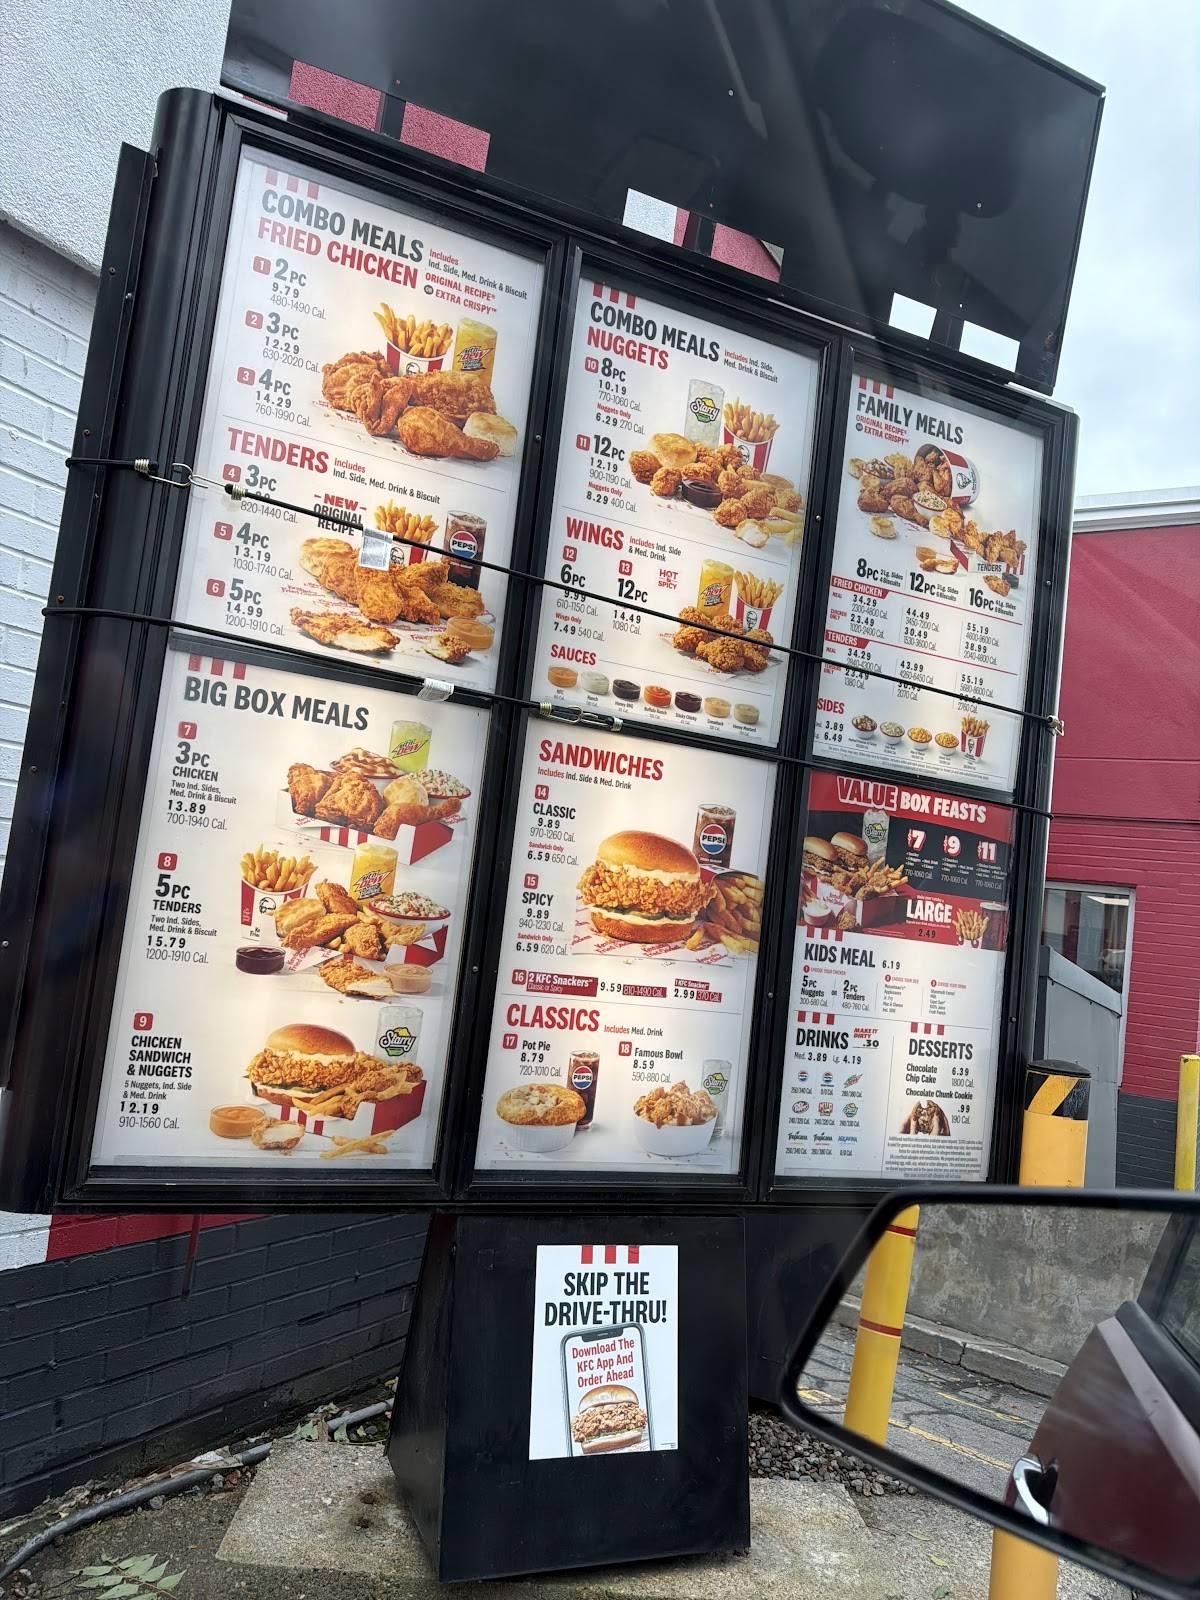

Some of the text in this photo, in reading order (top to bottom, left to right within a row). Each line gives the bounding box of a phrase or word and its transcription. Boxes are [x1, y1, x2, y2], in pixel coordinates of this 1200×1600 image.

[262, 189, 423, 262] COMBO MEALS
[258, 217, 418, 288] FRIED CHICKEN
[430, 249, 458, 265] Includes
[425, 273, 462, 292] ORIGINAL
[429, 260, 527, 299] Ind. Side, Med. Drink & Biscuit
[272, 283, 300, 299] 9.79
[270, 295, 327, 319] 480-1490 Cal.
[591, 302, 720, 361] COMBO MEALS
[265, 336, 300, 355] 12.29
[587, 326, 669, 369] NUGGETS
[599, 379, 626, 395] 10.19
[256, 391, 292, 408] 14.29
[857, 392, 963, 444] FAMILY MEALS
[228, 427, 365, 474] TENDERS Includes
[590, 457, 618, 472] 12.19
[566, 516, 681, 556] WINGS Includes Ind. Side
[452, 540, 476, 551] PEPSI
[235, 546, 271, 562] 13.19
[659, 569, 678, 579] HOT
[977, 563, 1002, 572] TENDERS
[658, 581, 678, 590] SPICY
[834, 578, 882, 596] FRIED CHICKEN
[853, 594, 877, 607] 34.29
[226, 602, 263, 617] 14.99
[614, 610, 641, 624] 14.49
[554, 622, 576, 634] 7.49
[967, 623, 989, 634] 55.19
[828, 632, 857, 645] TENDERS
[551, 644, 596, 665] SAUCES
[184, 676, 369, 730] BIG BOX MEALS
[817, 698, 844, 714] SIDES
[185, 725, 191, 736] 7
[539, 739, 663, 781] SANDWICHES
[173, 766, 219, 782] CHICKEN
[170, 789, 186, 798] Med.
[188, 792, 206, 800] Drink
[214, 794, 237, 804] Biscuit
[837, 776, 987, 823] VALUE BOX FEASTS
[168, 800, 206, 814] 13.89
[533, 803, 576, 820] CLASSIC
[538, 818, 560, 829] 9.89
[702, 834, 725, 843] PEPSI
[164, 856, 171, 867] 8
[528, 851, 550, 862] 6.59
[522, 892, 554, 906] SPICY
[153, 900, 202, 914] TENDERS
[527, 908, 549, 919] 9.89
[906, 899, 952, 923] LARGE
[147, 935, 186, 948] 15.79
[804, 943, 900, 969] KIDS MEAL 6.19
[514, 972, 524, 982] 16
[529, 974, 534, 982] 2
[536, 973, 551, 983] KFC
[600, 982, 621, 992] 9.59
[801, 988, 824, 997] Nuggets
[843, 992, 865, 1001] Tenders
[140, 1016, 147, 1027] 9
[507, 1003, 663, 1036] CLASSICS Includes Med. Drink
[132, 1035, 182, 1049] CHICKEN
[379, 1031, 416, 1050] Starry
[506, 1036, 550, 1051] 17 Pot Pie
[796, 1028, 849, 1049] DRINKS
[129, 1050, 191, 1063] SANDWICH
[621, 1044, 683, 1060] 18 Famous Bowl
[909, 1039, 973, 1060] DESSERTS
[521, 1053, 544, 1062] 8.79
[633, 1060, 655, 1069] 8.59
[808, 1052, 861, 1064] 3.89 4.19
[127, 1065, 192, 1077] & NUGGETS
[906, 1063, 969, 1076] Chocolate 6.39
[131, 1081, 161, 1090] Nuggets,
[906, 1074, 936, 1084] Chip Cake
[906, 1088, 973, 1100] Chocolate Chunk Cookie
[120, 1102, 159, 1114] 12.19
[958, 1105, 970, 1113] .99
[119, 1116, 179, 1129] 910-1560 Cal.
[564, 1272, 649, 1296] SKIP THE
[545, 1300, 666, 1326] DRIVE-THRU!
[572, 1339, 634, 1359] Download The
[577, 1355, 633, 1373] KFC App And
[578, 1367, 634, 1388] Order Ahead
